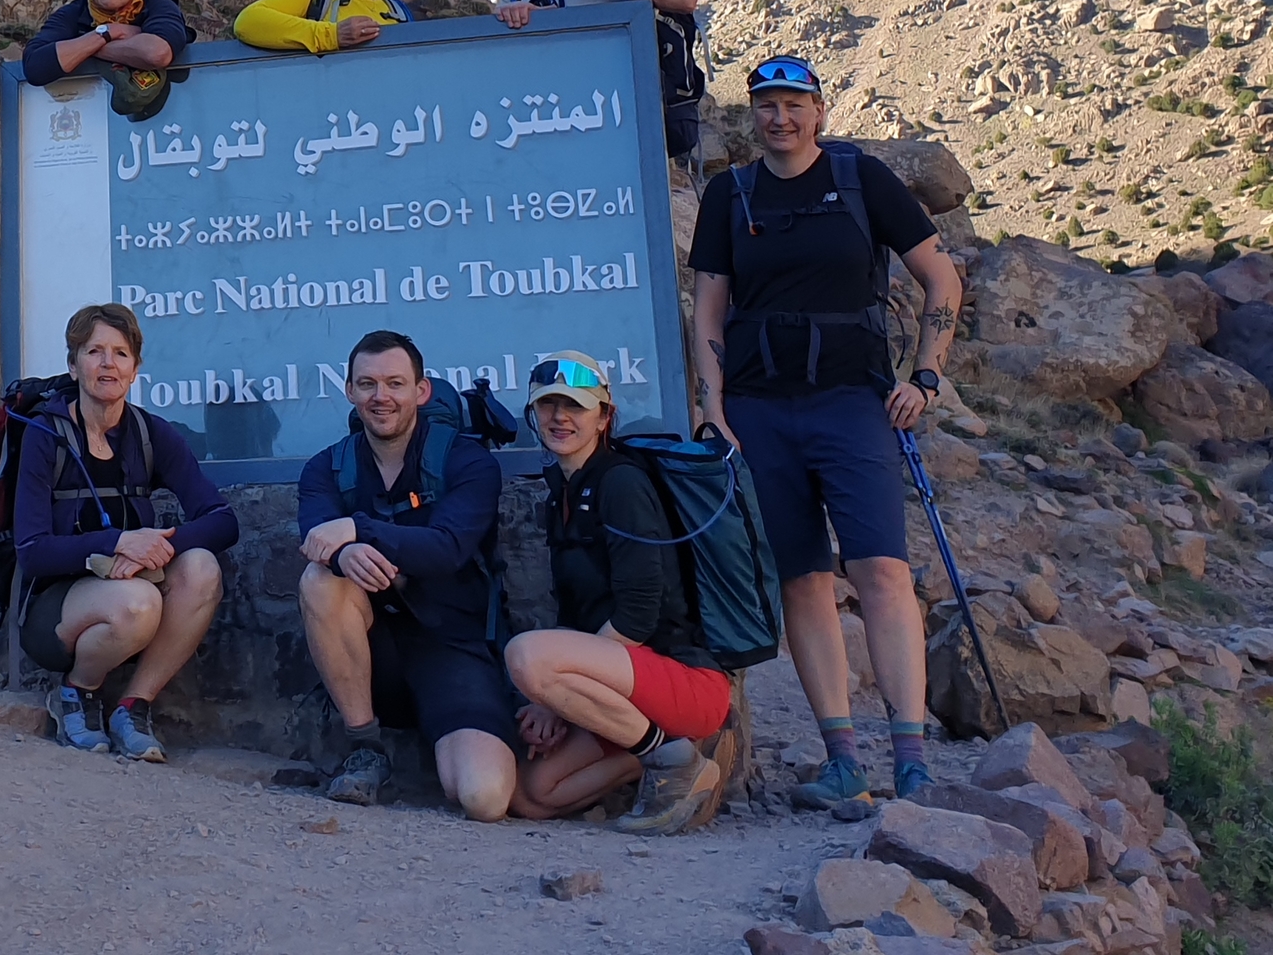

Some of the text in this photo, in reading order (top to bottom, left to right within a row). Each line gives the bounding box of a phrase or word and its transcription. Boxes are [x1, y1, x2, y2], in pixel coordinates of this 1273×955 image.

[117, 89, 623, 181] المنتزه الوطني لتوبقال
[117, 252, 639, 318] Parc National de Toubkal
[129, 363, 301, 409] Toubkal
